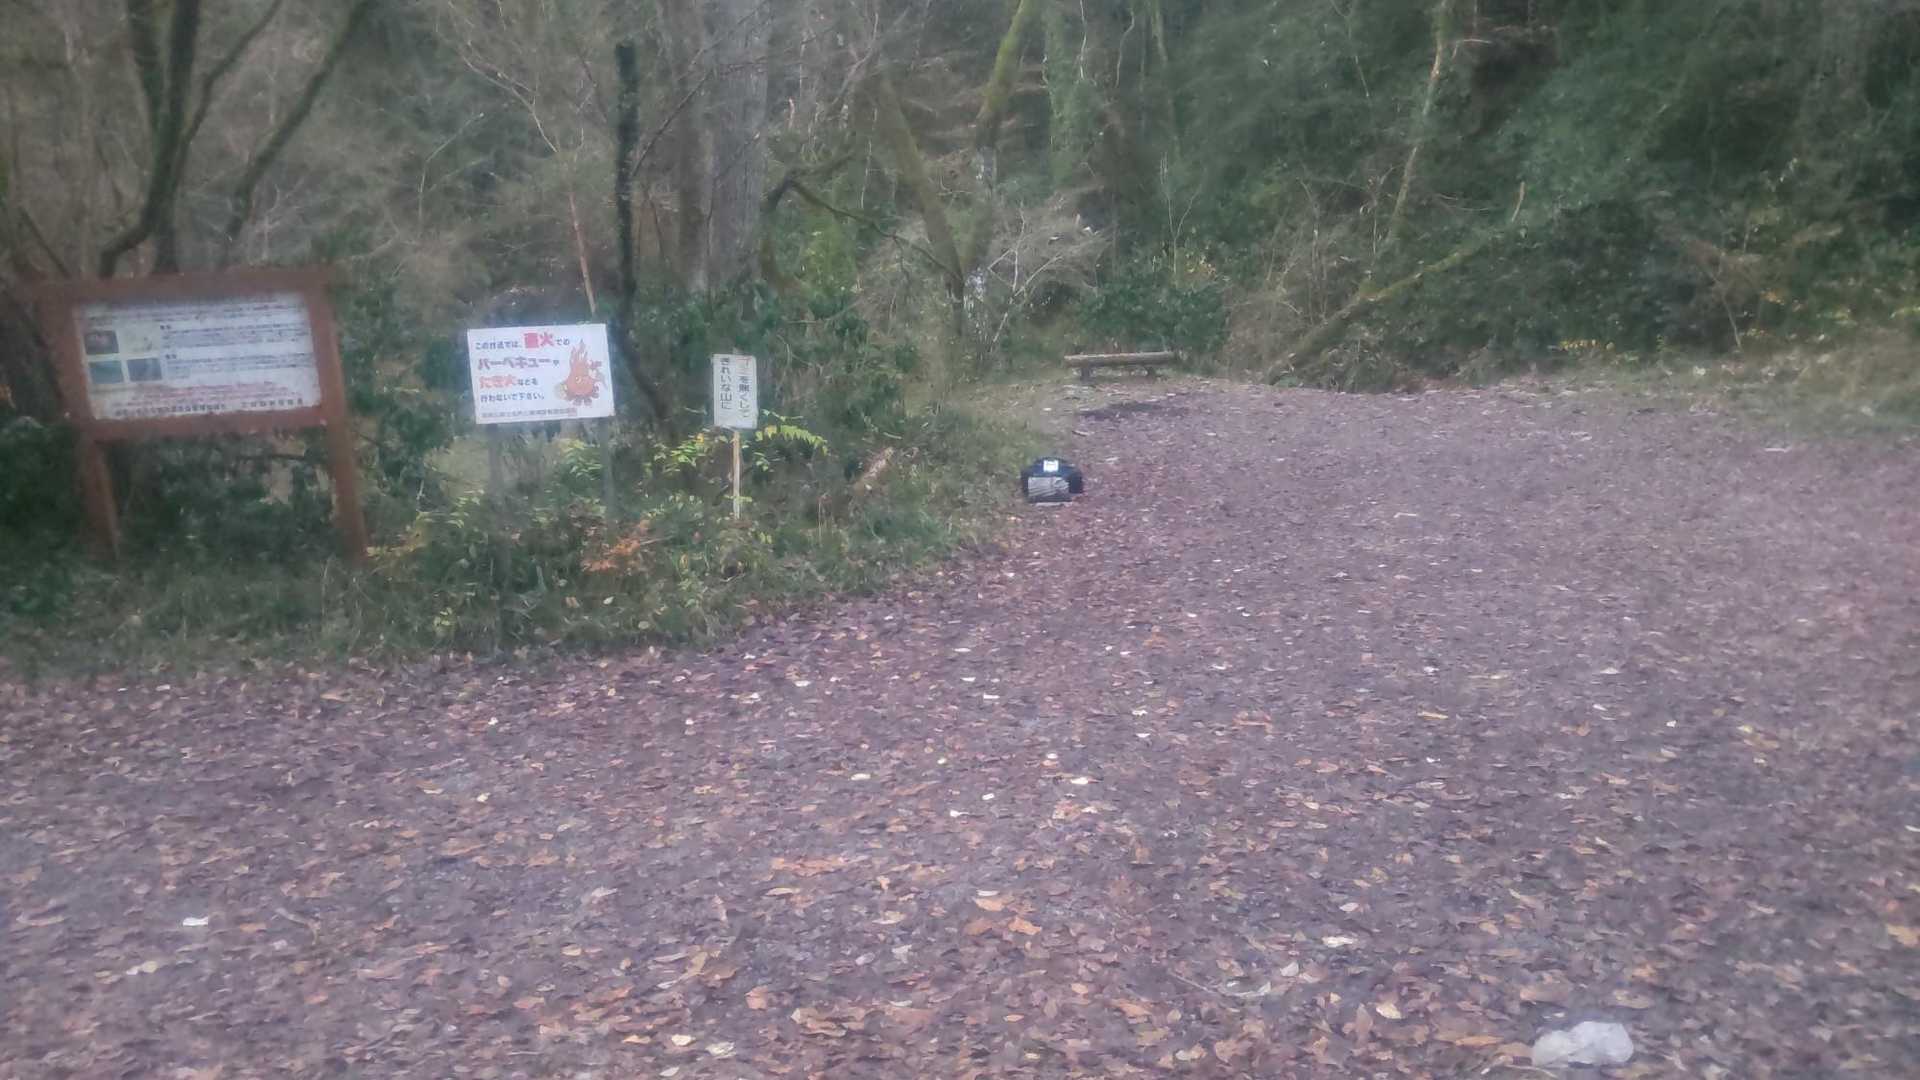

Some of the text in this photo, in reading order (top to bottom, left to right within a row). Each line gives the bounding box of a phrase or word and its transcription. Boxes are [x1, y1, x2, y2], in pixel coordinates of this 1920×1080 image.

[720, 357, 732, 410] きれいな山に
